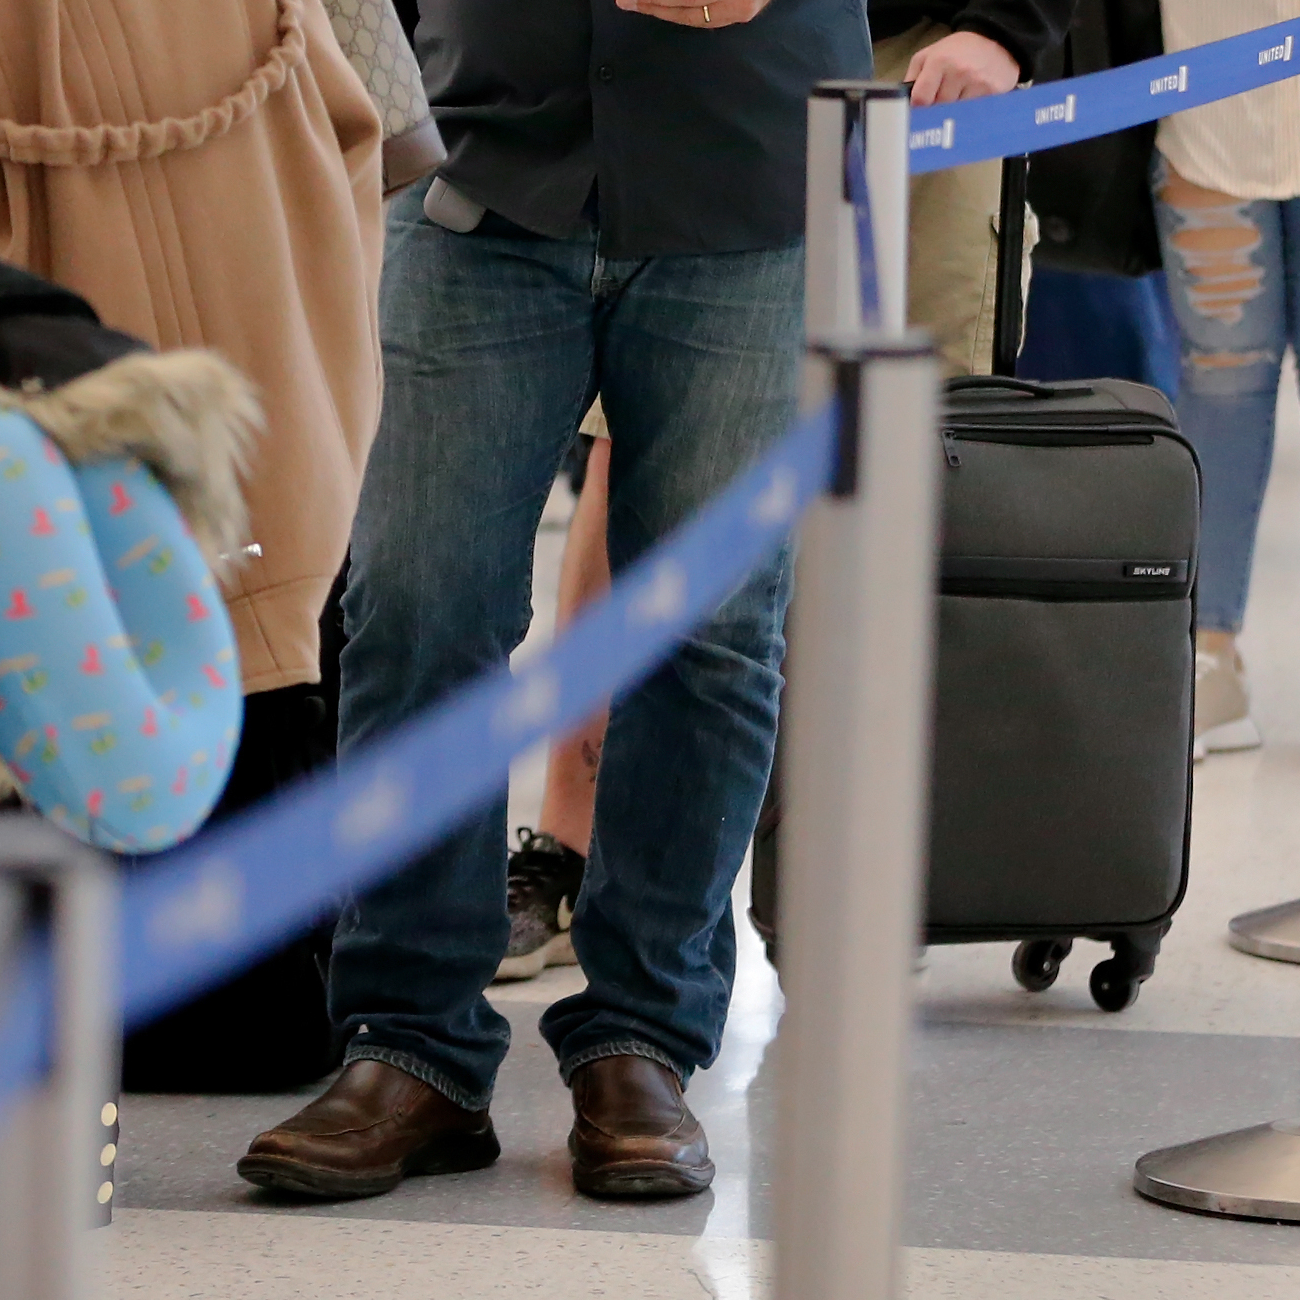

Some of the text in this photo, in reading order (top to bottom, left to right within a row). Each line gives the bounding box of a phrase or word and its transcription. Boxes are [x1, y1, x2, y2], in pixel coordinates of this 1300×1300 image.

[1258, 44, 1284, 65] UNITED
[1150, 75, 1178, 95] UNITED
[1034, 102, 1065, 126] UNITED
